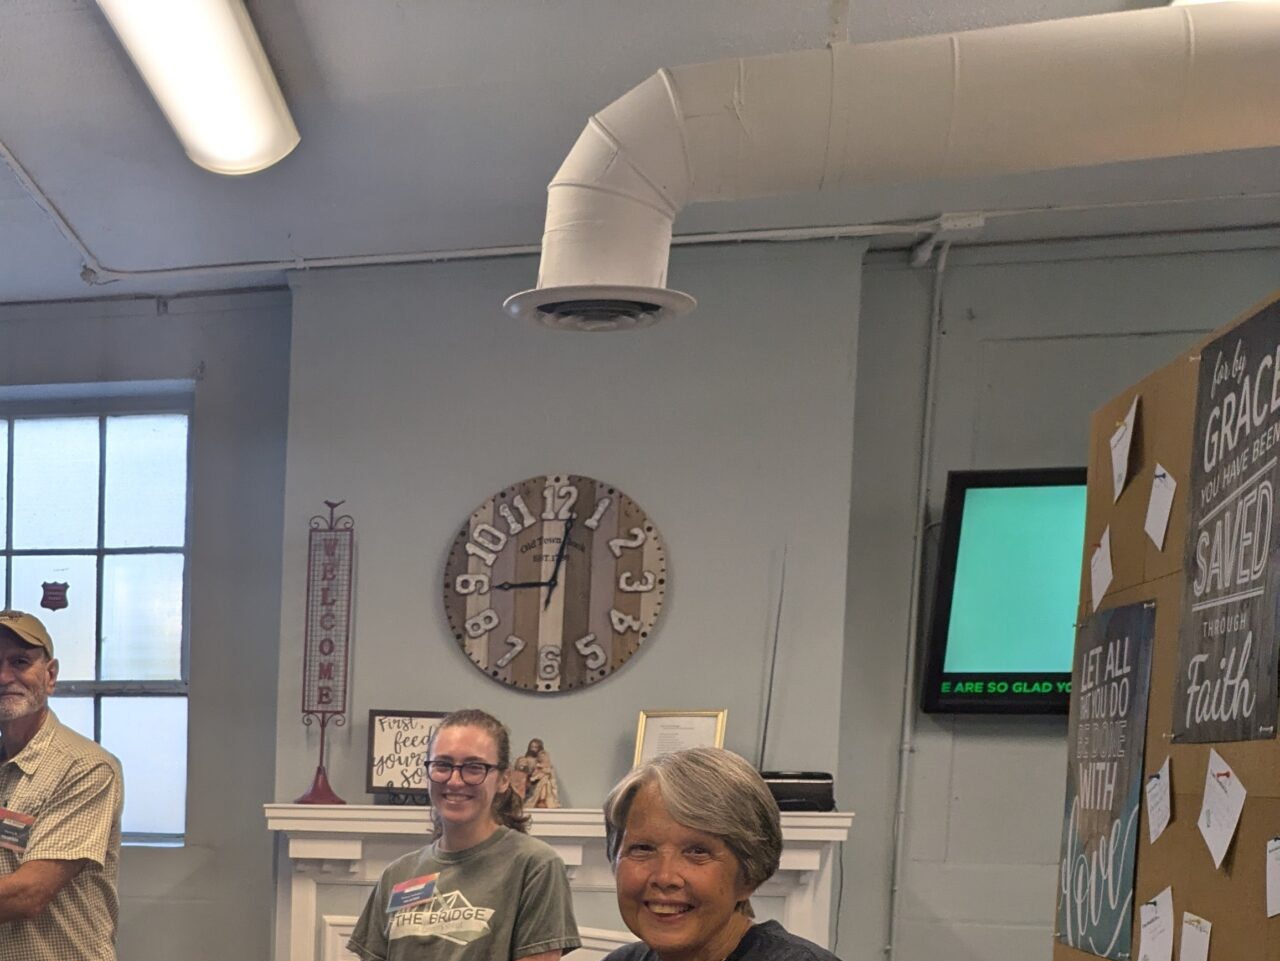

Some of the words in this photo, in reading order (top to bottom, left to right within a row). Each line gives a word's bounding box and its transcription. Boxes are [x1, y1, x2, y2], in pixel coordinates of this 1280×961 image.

[1201, 474, 1219, 507] YOU
[1222, 448, 1249, 488] HAVE
[1252, 422, 1280, 463] BEEN
[498, 495, 537, 535] 11
[541, 485, 578, 521] 12
[584, 497, 612, 530] 1
[465, 523, 507, 566] 10
[608, 527, 646, 558] 2
[1193, 480, 1273, 597] SAVED
[455, 573, 490, 595] 9
[619, 571, 655, 593] 3
[317, 538, 338, 705] WELCOME
[465, 609, 500, 638] 8
[610, 608, 643, 635] 4
[1203, 615, 1247, 638] THROUGH
[496, 635, 527, 668] 7
[539, 645, 561, 681] 6
[575, 633, 608, 670] 5
[1080, 646, 1102, 692] LET
[1104, 637, 1131, 681] ALL
[954, 682, 984, 693] ARE
[987, 682, 1009, 693] SO
[1012, 682, 1053, 693] GLAD
[1056, 682, 1072, 693] YO
[1185, 630, 1256, 729] Faith
[1091, 684, 1107, 719] YOU
[1110, 677, 1129, 717] DO
[394, 726, 432, 754] feed
[1079, 761, 1118, 811] WITH
[396, 914, 422, 927] THE
[429, 909, 486, 925] BRIDGE
